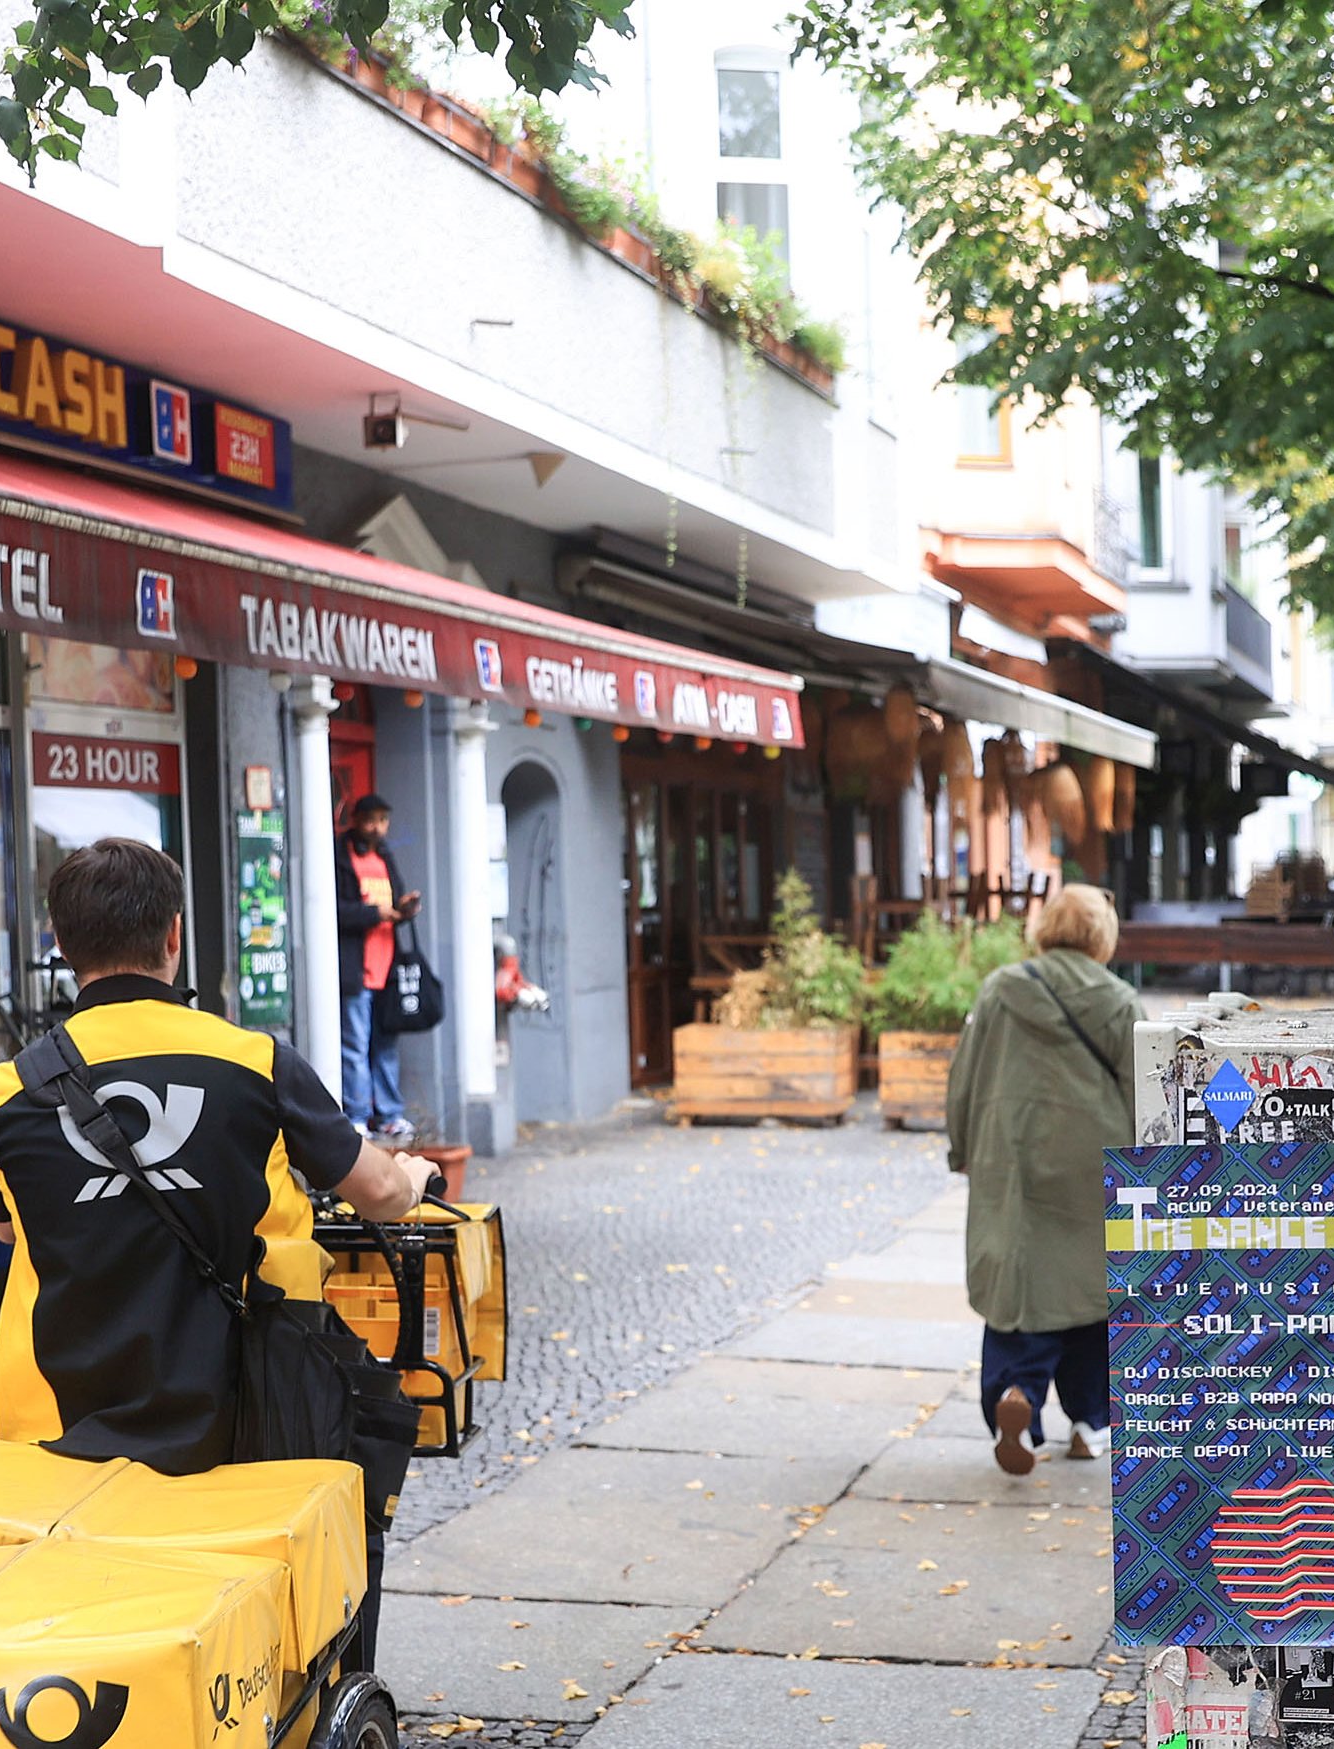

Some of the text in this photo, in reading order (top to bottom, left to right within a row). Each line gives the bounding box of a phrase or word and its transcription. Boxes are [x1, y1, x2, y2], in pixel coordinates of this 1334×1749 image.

[240, 594, 437, 682] TABAKWAREN
[526, 655, 618, 713] GETRÄNKE
[48, 743, 160, 784] 23 HOUR
[1204, 1090, 1255, 1101] SALMARI
[1167, 1184, 1278, 1198] 27.09.2024
[1311, 1184, 1323, 1196] 9
[1168, 1201, 1211, 1214] ACUD
[1207, 1215, 1326, 1249] DANCE
[1124, 1366, 1147, 1379] DJ
[1158, 1366, 1273, 1379] DISCJOCKEY
[1125, 1393, 1193, 1406] ORACLE
[1205, 1392, 1239, 1405] B2B
[1251, 1392, 1297, 1405] PAPA
[1125, 1419, 1192, 1432] FEUCHT
[1126, 1445, 1183, 1458] DANCE
[1194, 1445, 1250, 1457] DEPOT
